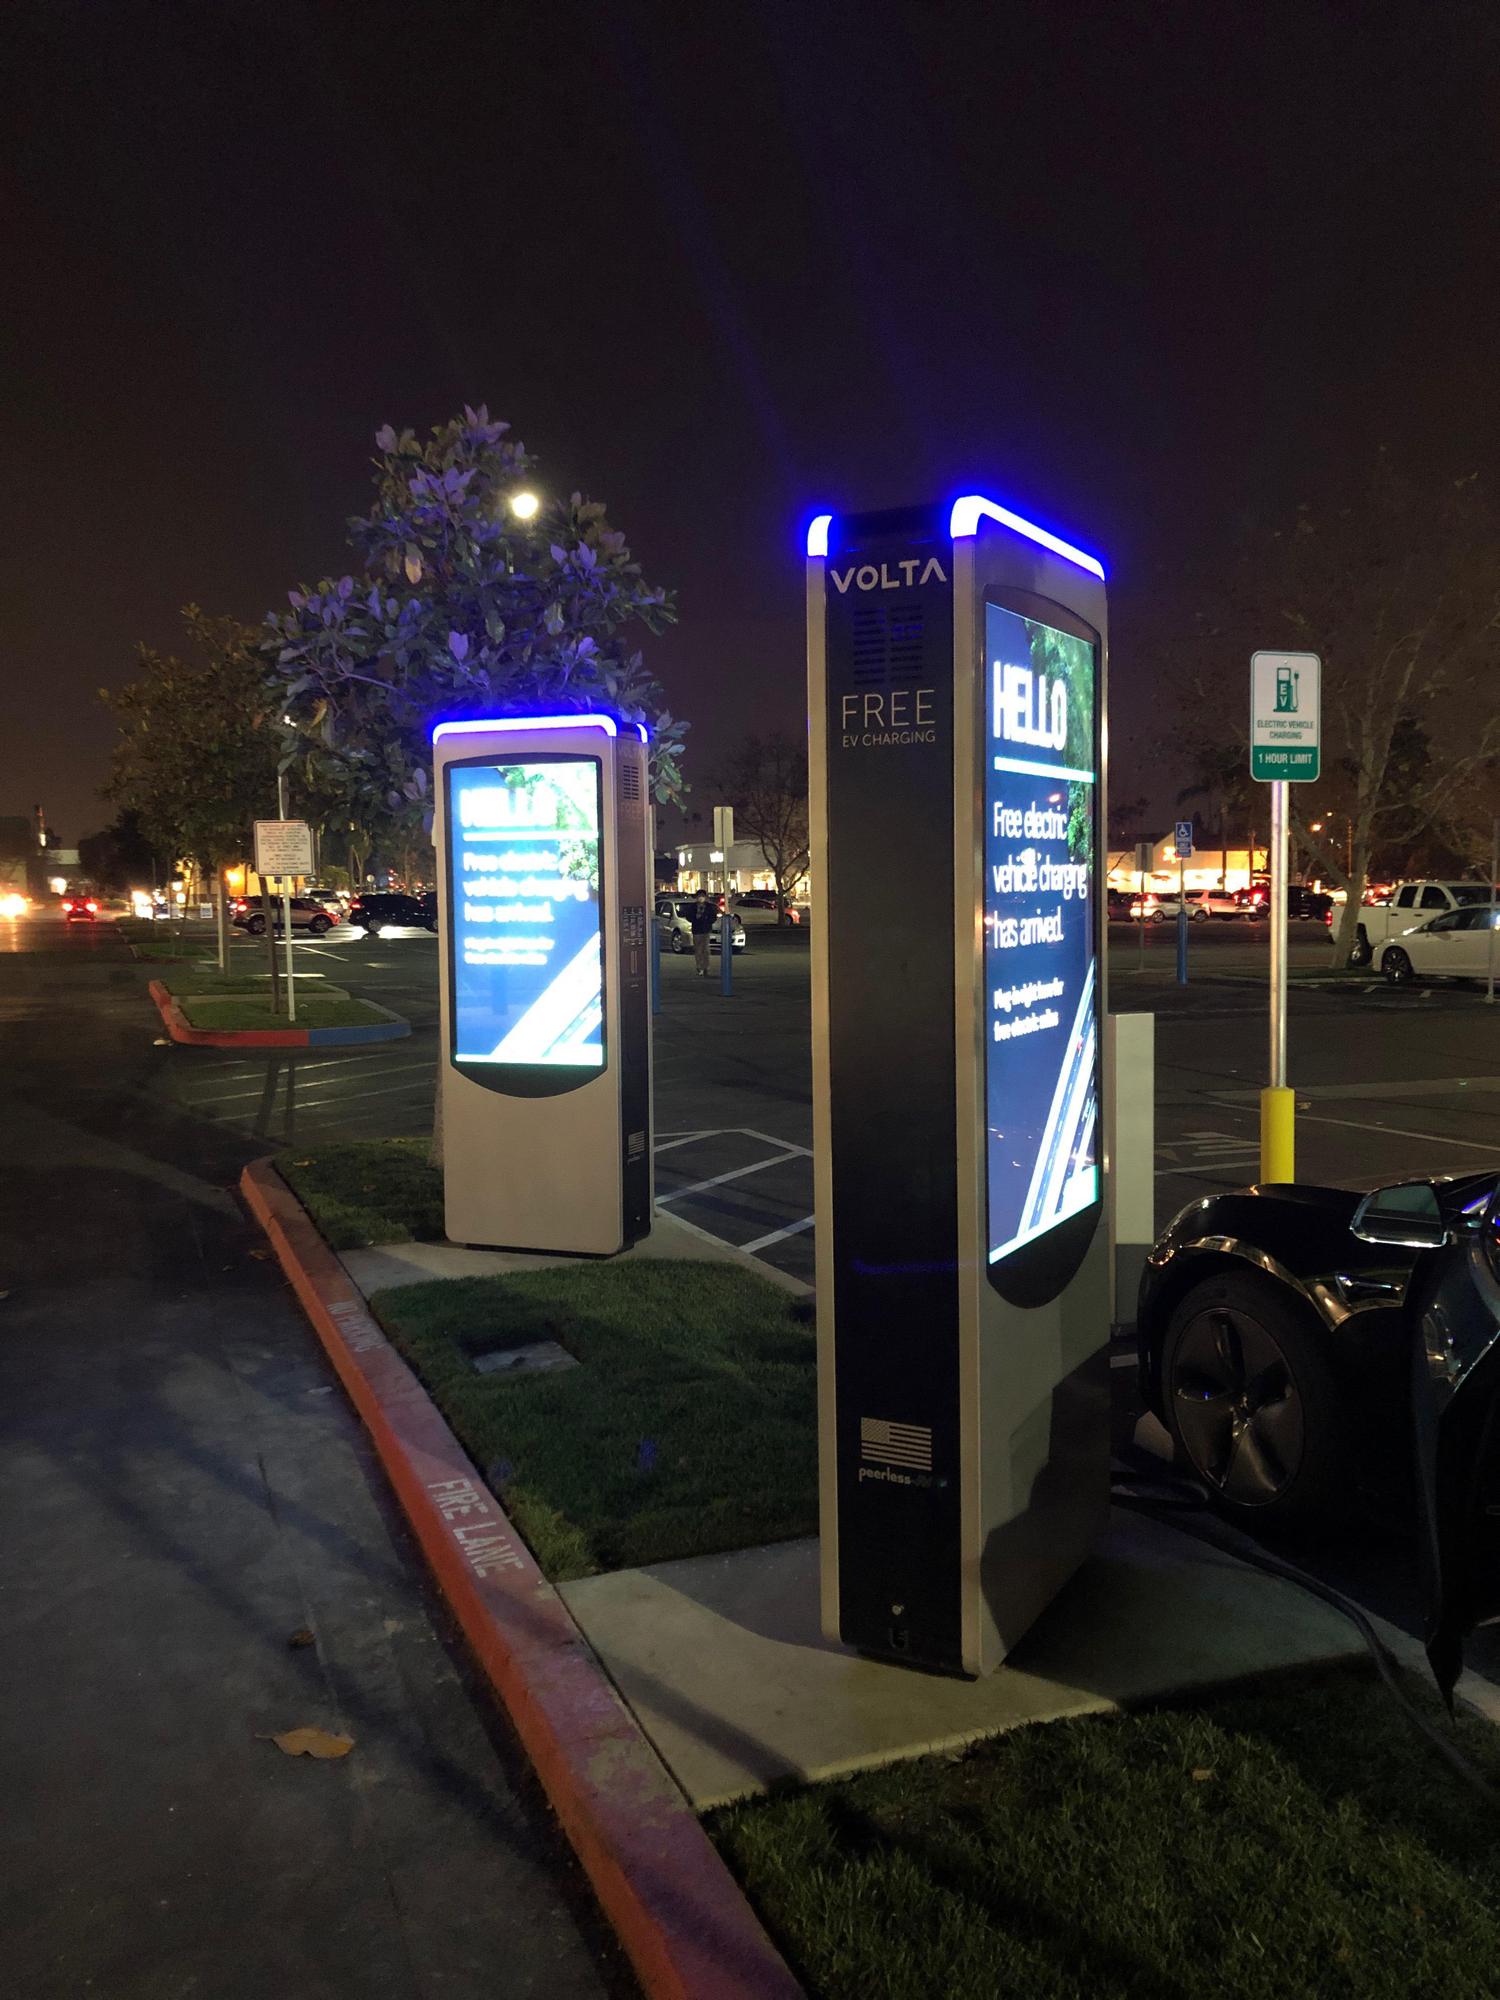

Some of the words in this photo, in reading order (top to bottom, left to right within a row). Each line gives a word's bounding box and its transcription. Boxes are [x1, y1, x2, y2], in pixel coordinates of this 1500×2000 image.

[830, 557, 947, 594] VOLTA
[842, 689, 936, 729] FREE
[993, 661, 1067, 750] HELLO
[1257, 720, 1287, 730] ELECTRIC
[1289, 720, 1313, 730] VEHICLE
[842, 734, 860, 748] EV
[862, 729, 936, 747] CHARGING
[1269, 731, 1302, 740] CHARGING
[1258, 752, 1264, 764] 1
[1265, 752, 1288, 765] HOUR
[1290, 753, 1313, 765] LIMIT
[993, 801, 1022, 838] Free
[1024, 801, 1068, 840] electric
[993, 854, 1038, 893] vehicle
[1039, 854, 1088, 900] charging
[993, 910, 1018, 949] has
[427, 1477, 488, 1520] FIRE
[453, 1522, 524, 1578] LANE
